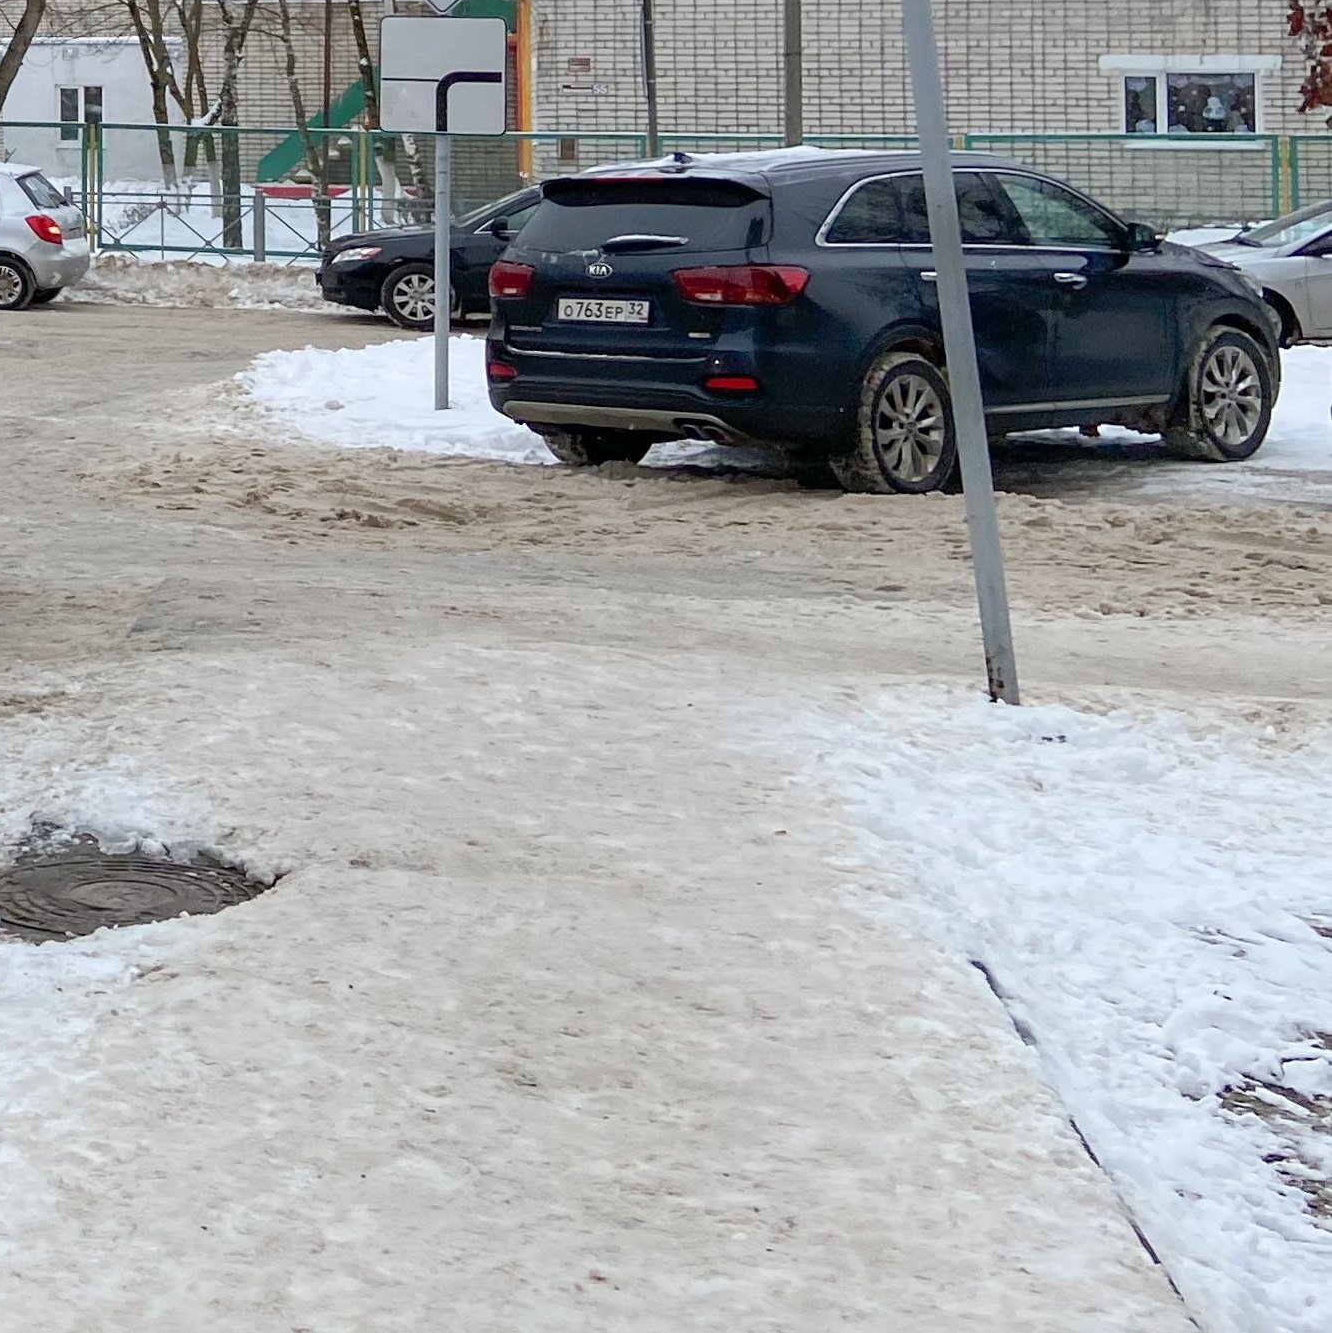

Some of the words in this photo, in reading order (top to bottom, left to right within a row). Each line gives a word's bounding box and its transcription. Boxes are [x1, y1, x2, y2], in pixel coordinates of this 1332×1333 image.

[587, 265, 608, 275] KIA
[564, 301, 624, 320] О763ЕР
[627, 302, 644, 316] 32
